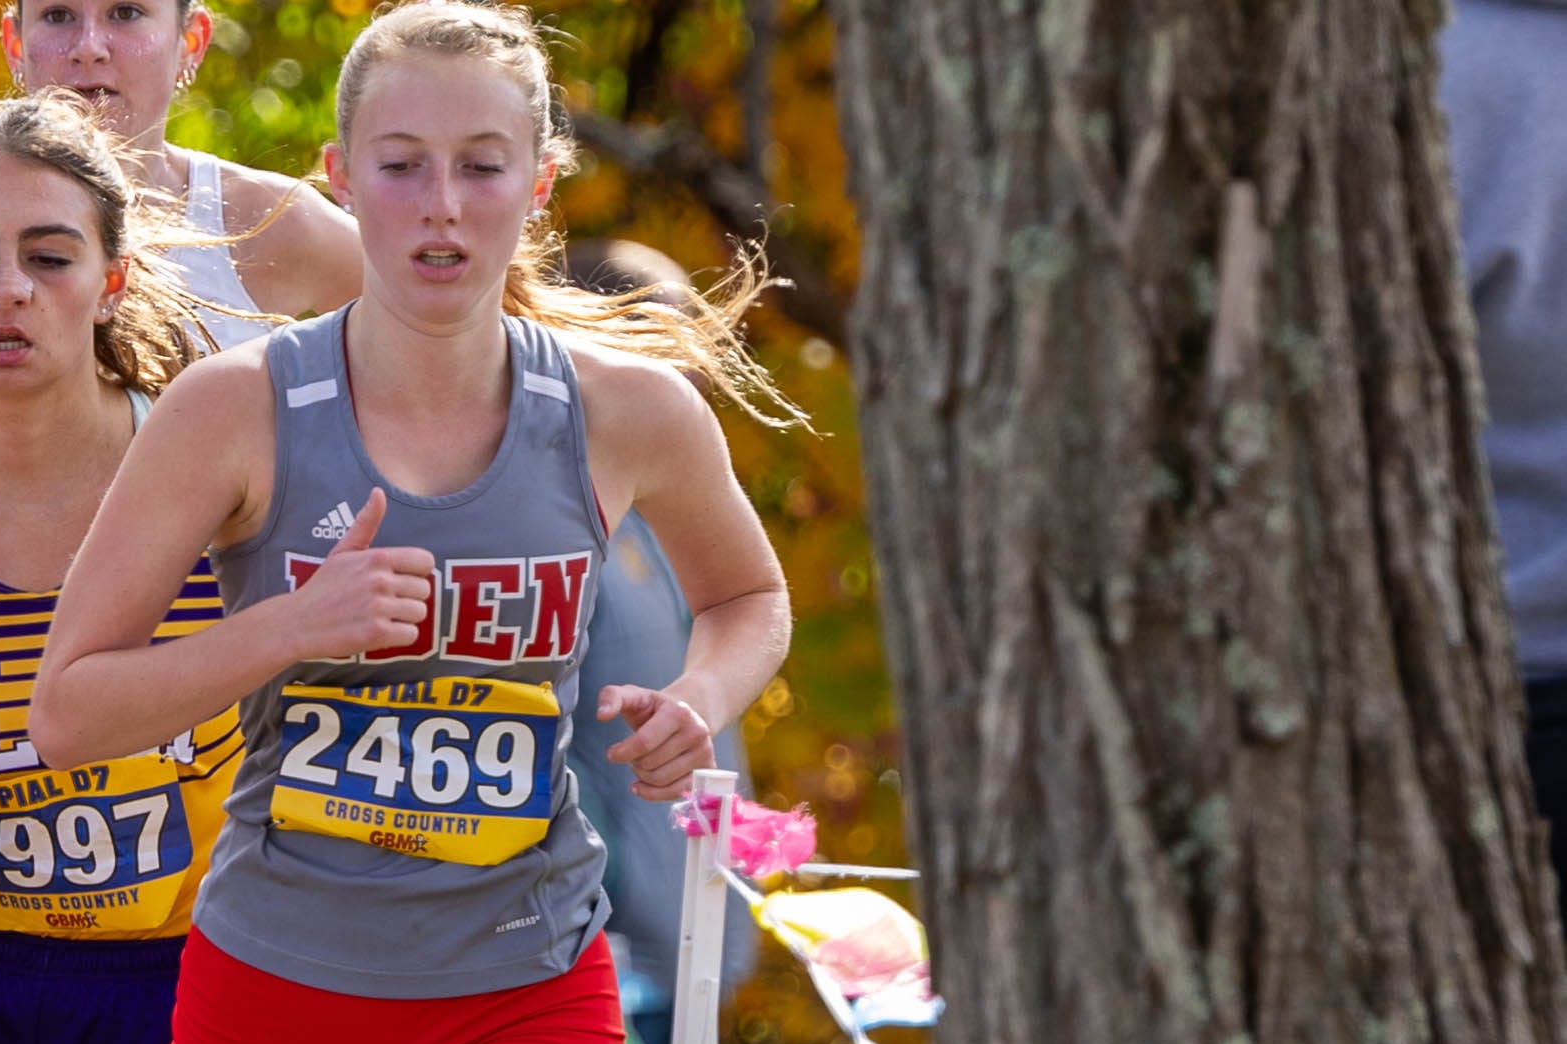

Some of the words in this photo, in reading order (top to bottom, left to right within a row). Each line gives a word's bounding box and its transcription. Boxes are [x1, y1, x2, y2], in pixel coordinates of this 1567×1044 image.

[311, 524, 348, 541] adid
[285, 550, 592, 666] EN
[448, 682, 493, 706] D7
[279, 702, 536, 809] 2469
[70, 765, 110, 793] D7
[324, 799, 385, 825] CROSS
[393, 812, 481, 835] COUNTRY
[59, 887, 140, 910] COUNTRY
